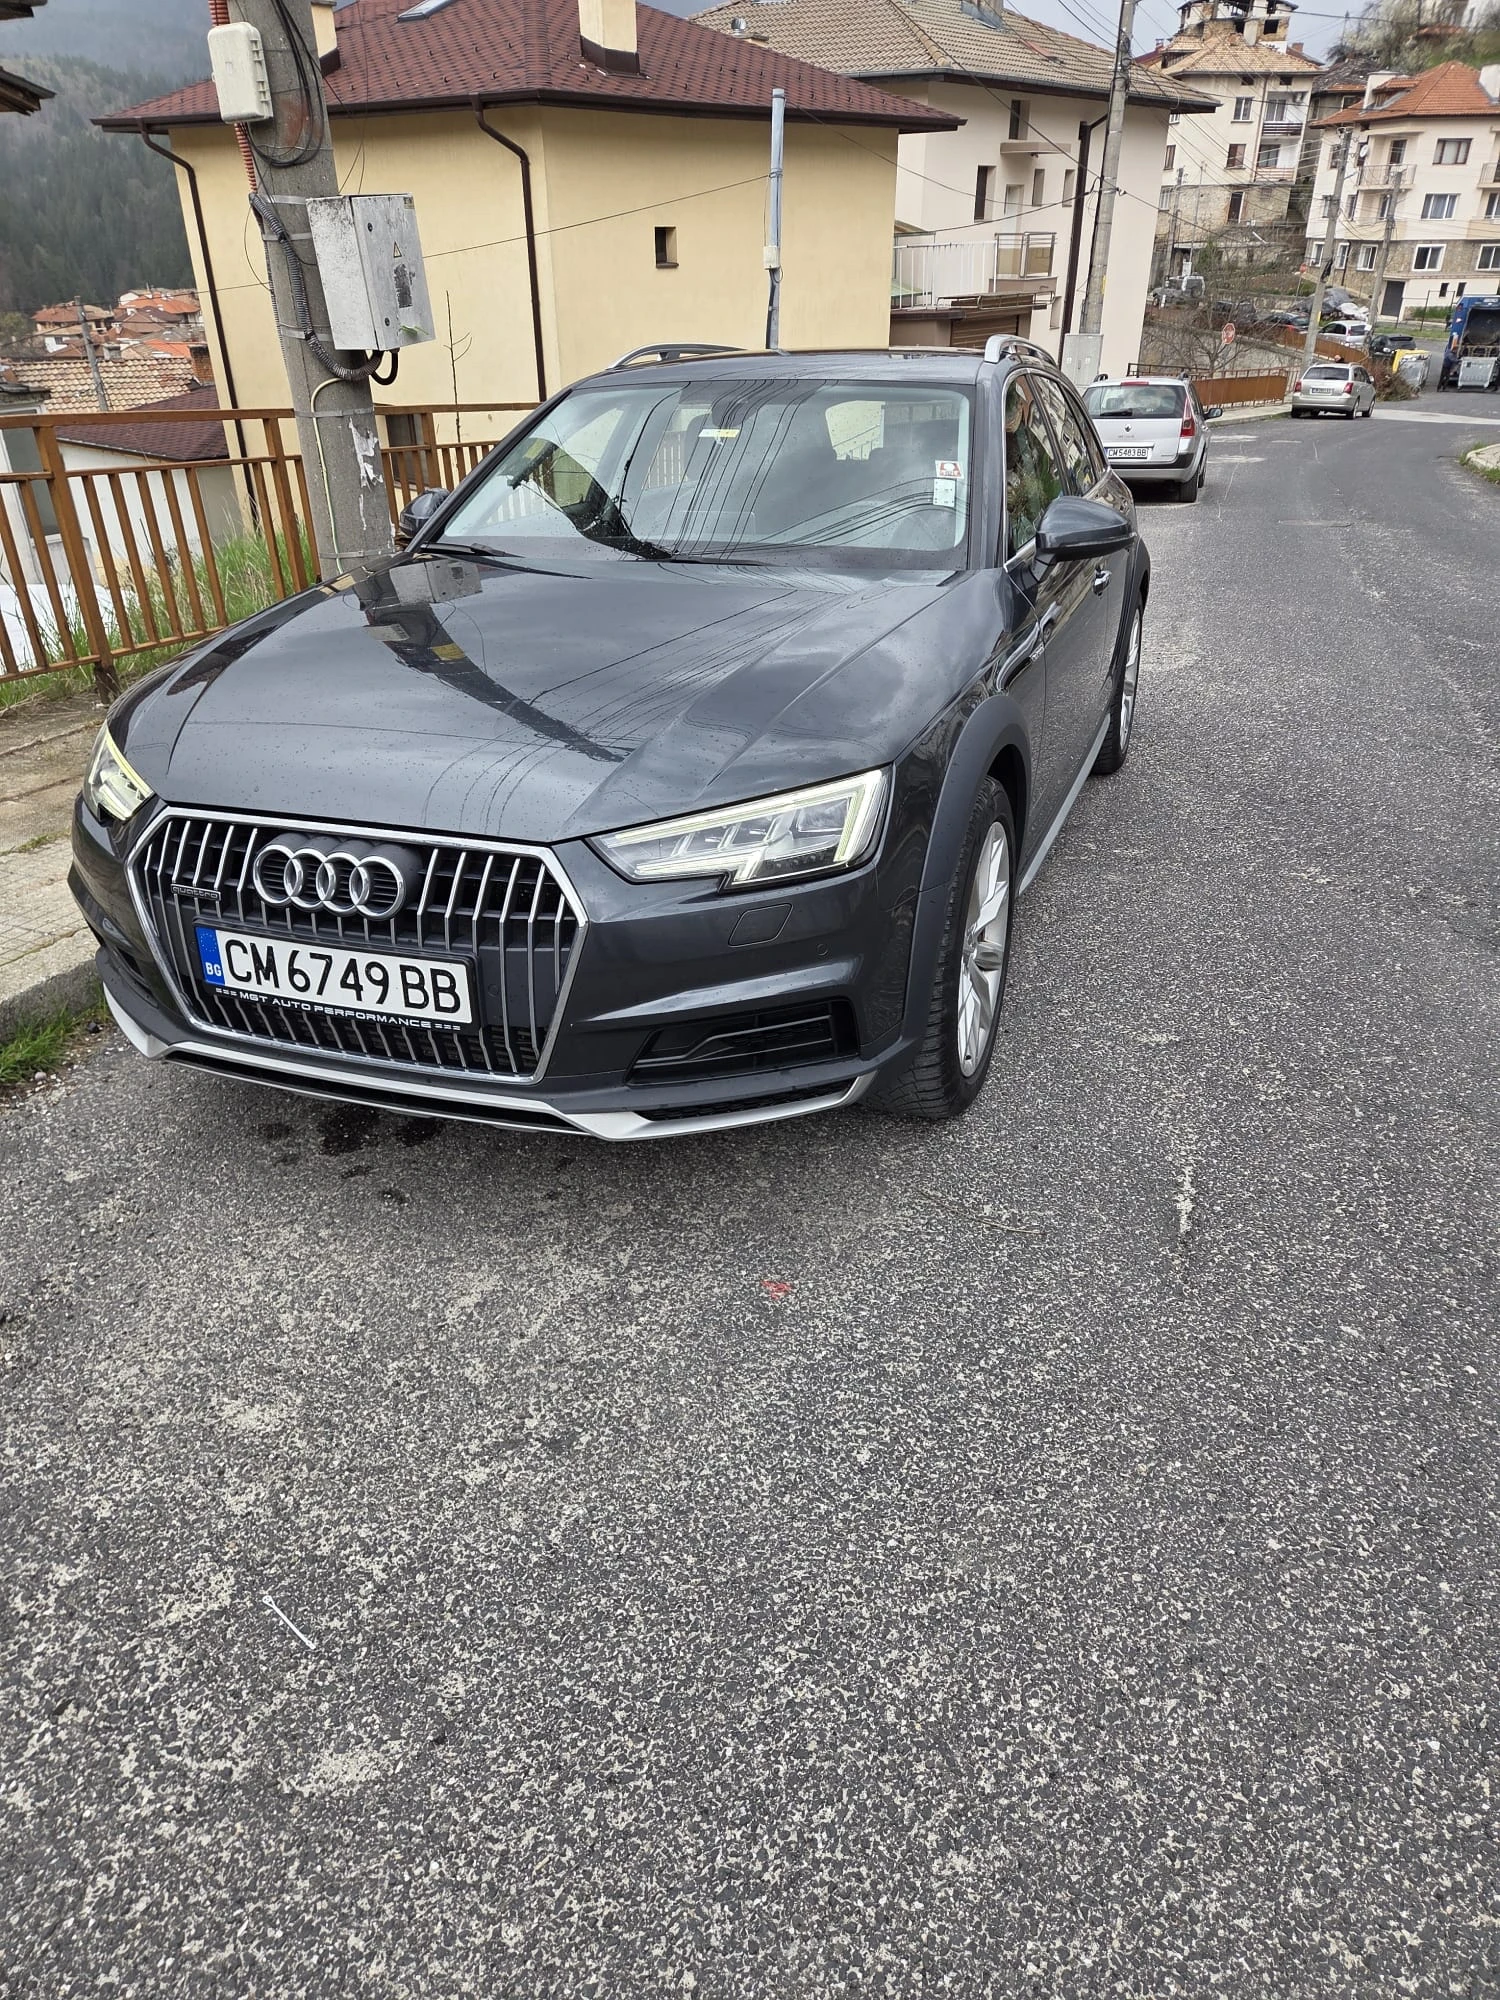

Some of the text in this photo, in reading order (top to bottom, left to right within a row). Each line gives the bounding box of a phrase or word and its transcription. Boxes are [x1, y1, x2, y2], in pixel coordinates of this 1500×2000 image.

[172, 886, 218, 897] quattro
[205, 962, 222, 977] BG
[272, 998, 311, 1011] AUTO
[313, 1005, 432, 1029] PERFORMANCE
